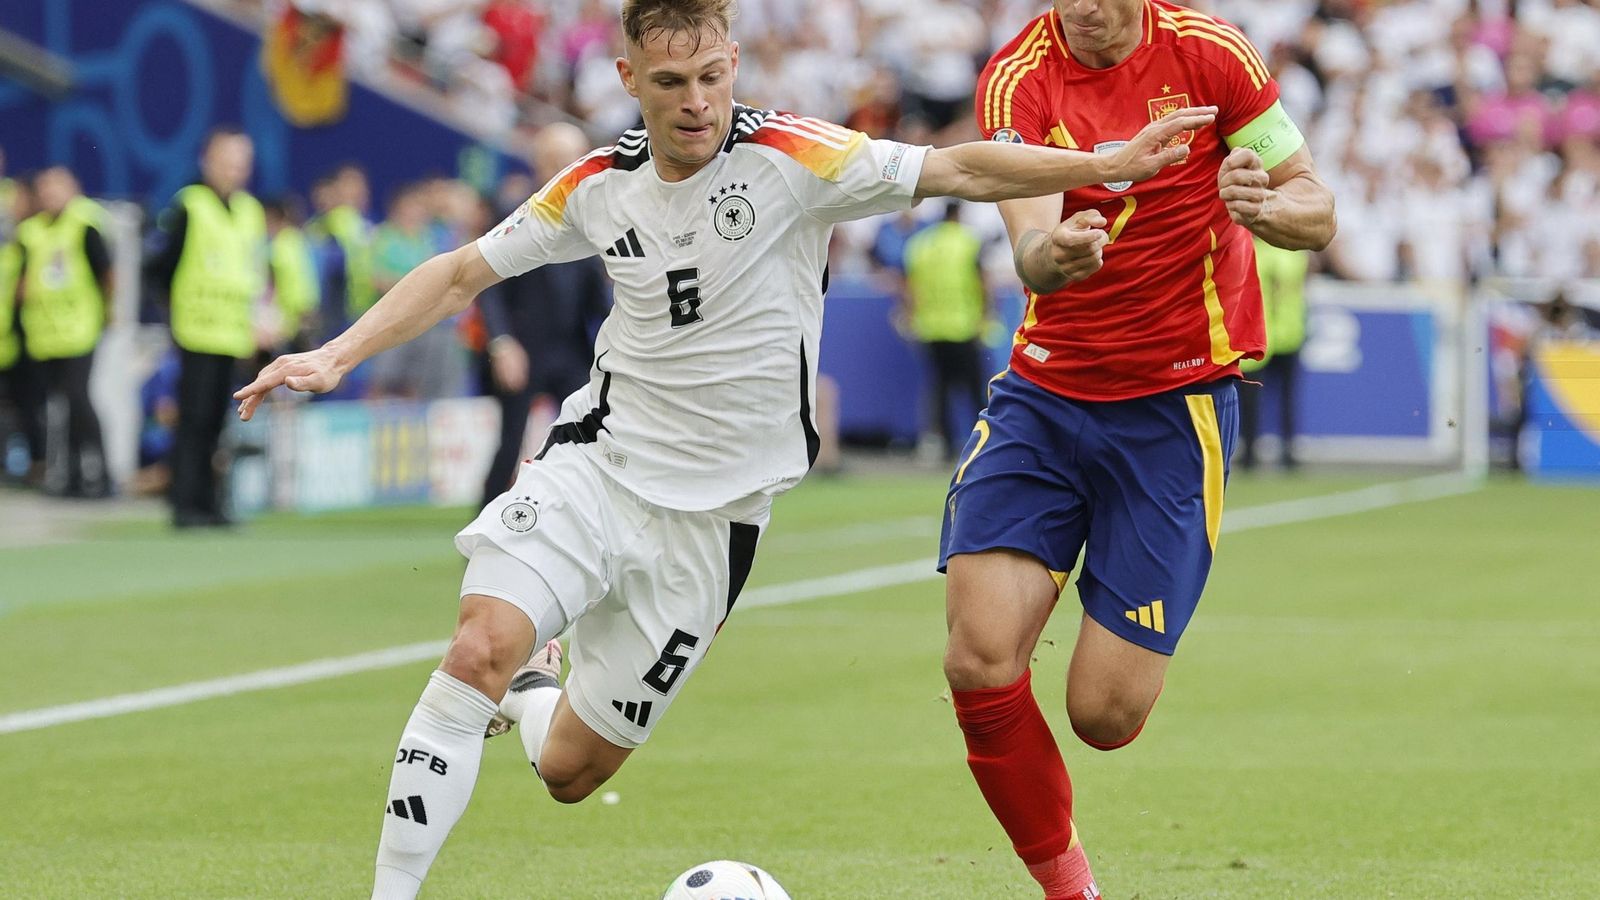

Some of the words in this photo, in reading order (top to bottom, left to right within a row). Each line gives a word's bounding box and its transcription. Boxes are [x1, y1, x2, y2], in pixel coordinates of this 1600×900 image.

[1103, 195, 1137, 244] 7
[666, 267, 704, 329] 6
[1173, 358, 1205, 370] HEAT.RDY
[956, 420, 990, 484] 7
[642, 628, 699, 696] 6
